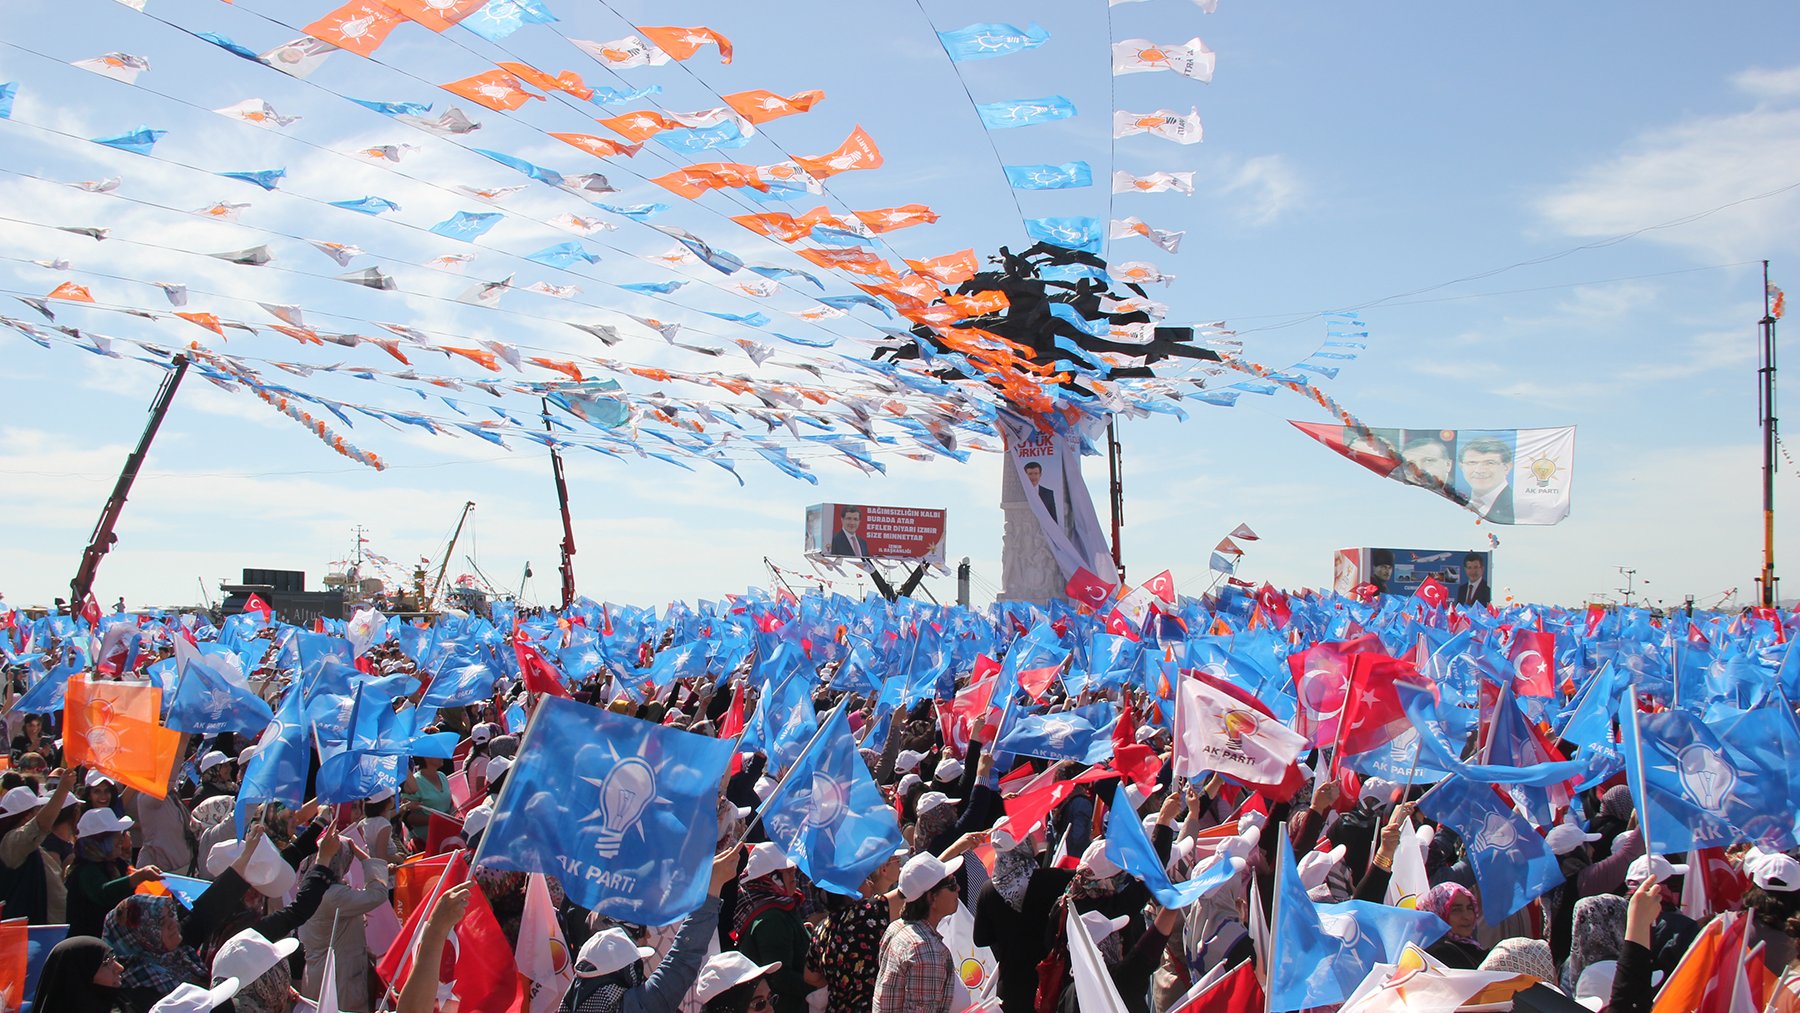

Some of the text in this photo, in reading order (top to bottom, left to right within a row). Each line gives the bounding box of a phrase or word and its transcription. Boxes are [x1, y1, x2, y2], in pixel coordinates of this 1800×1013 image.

[867, 516, 896, 524] BURADA
[294, 609, 322, 620] Altus
[1032, 748, 1047, 757] AK
[1202, 745, 1256, 766] AK PARTi
[1372, 761, 1388, 771] AK
[1693, 827, 1724, 841] AK
[556, 855, 637, 894] AK PARTi
[178, 891, 194, 903] AK
[397, 900, 404, 915] AK
